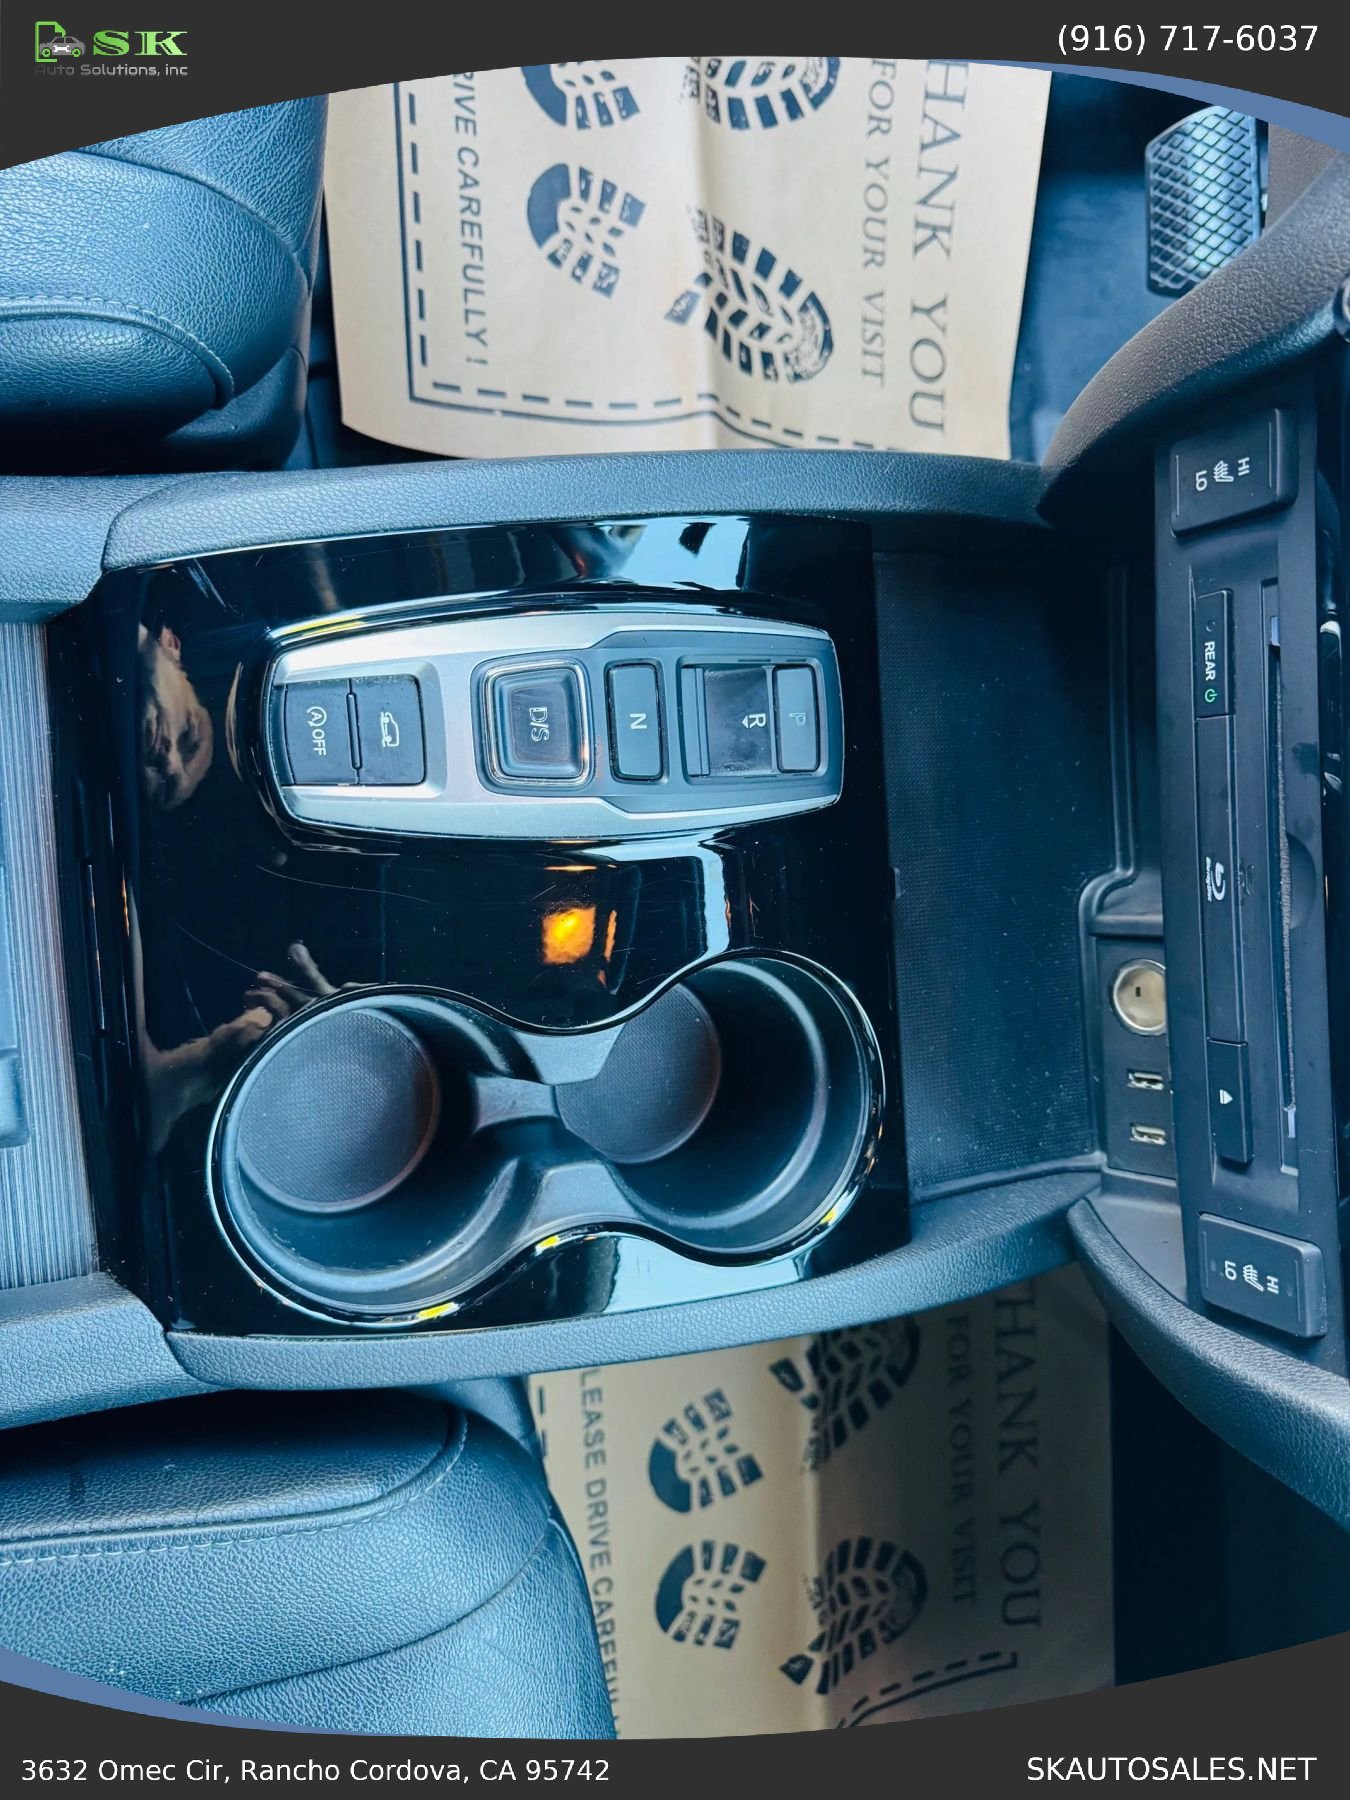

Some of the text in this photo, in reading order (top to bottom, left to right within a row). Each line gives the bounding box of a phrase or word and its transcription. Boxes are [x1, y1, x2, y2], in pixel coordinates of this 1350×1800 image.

[861, 58, 897, 388] FOR YOUR VISIT
[909, 294, 950, 433] YOU
[1195, 470, 1208, 491] LO
[1204, 641, 1216, 681] REAR
[529, 706, 550, 742] D/S
[630, 713, 648, 730] N
[749, 712, 767, 729] R
[789, 712, 806, 728] P
[311, 729, 326, 756] OFF
[1224, 1260, 1236, 1280] LO
[946, 1315, 976, 1605] FOR YOUR VISIT
[585, 1478, 613, 1571] DRIVE
[999, 1497, 1042, 1627] YOU
